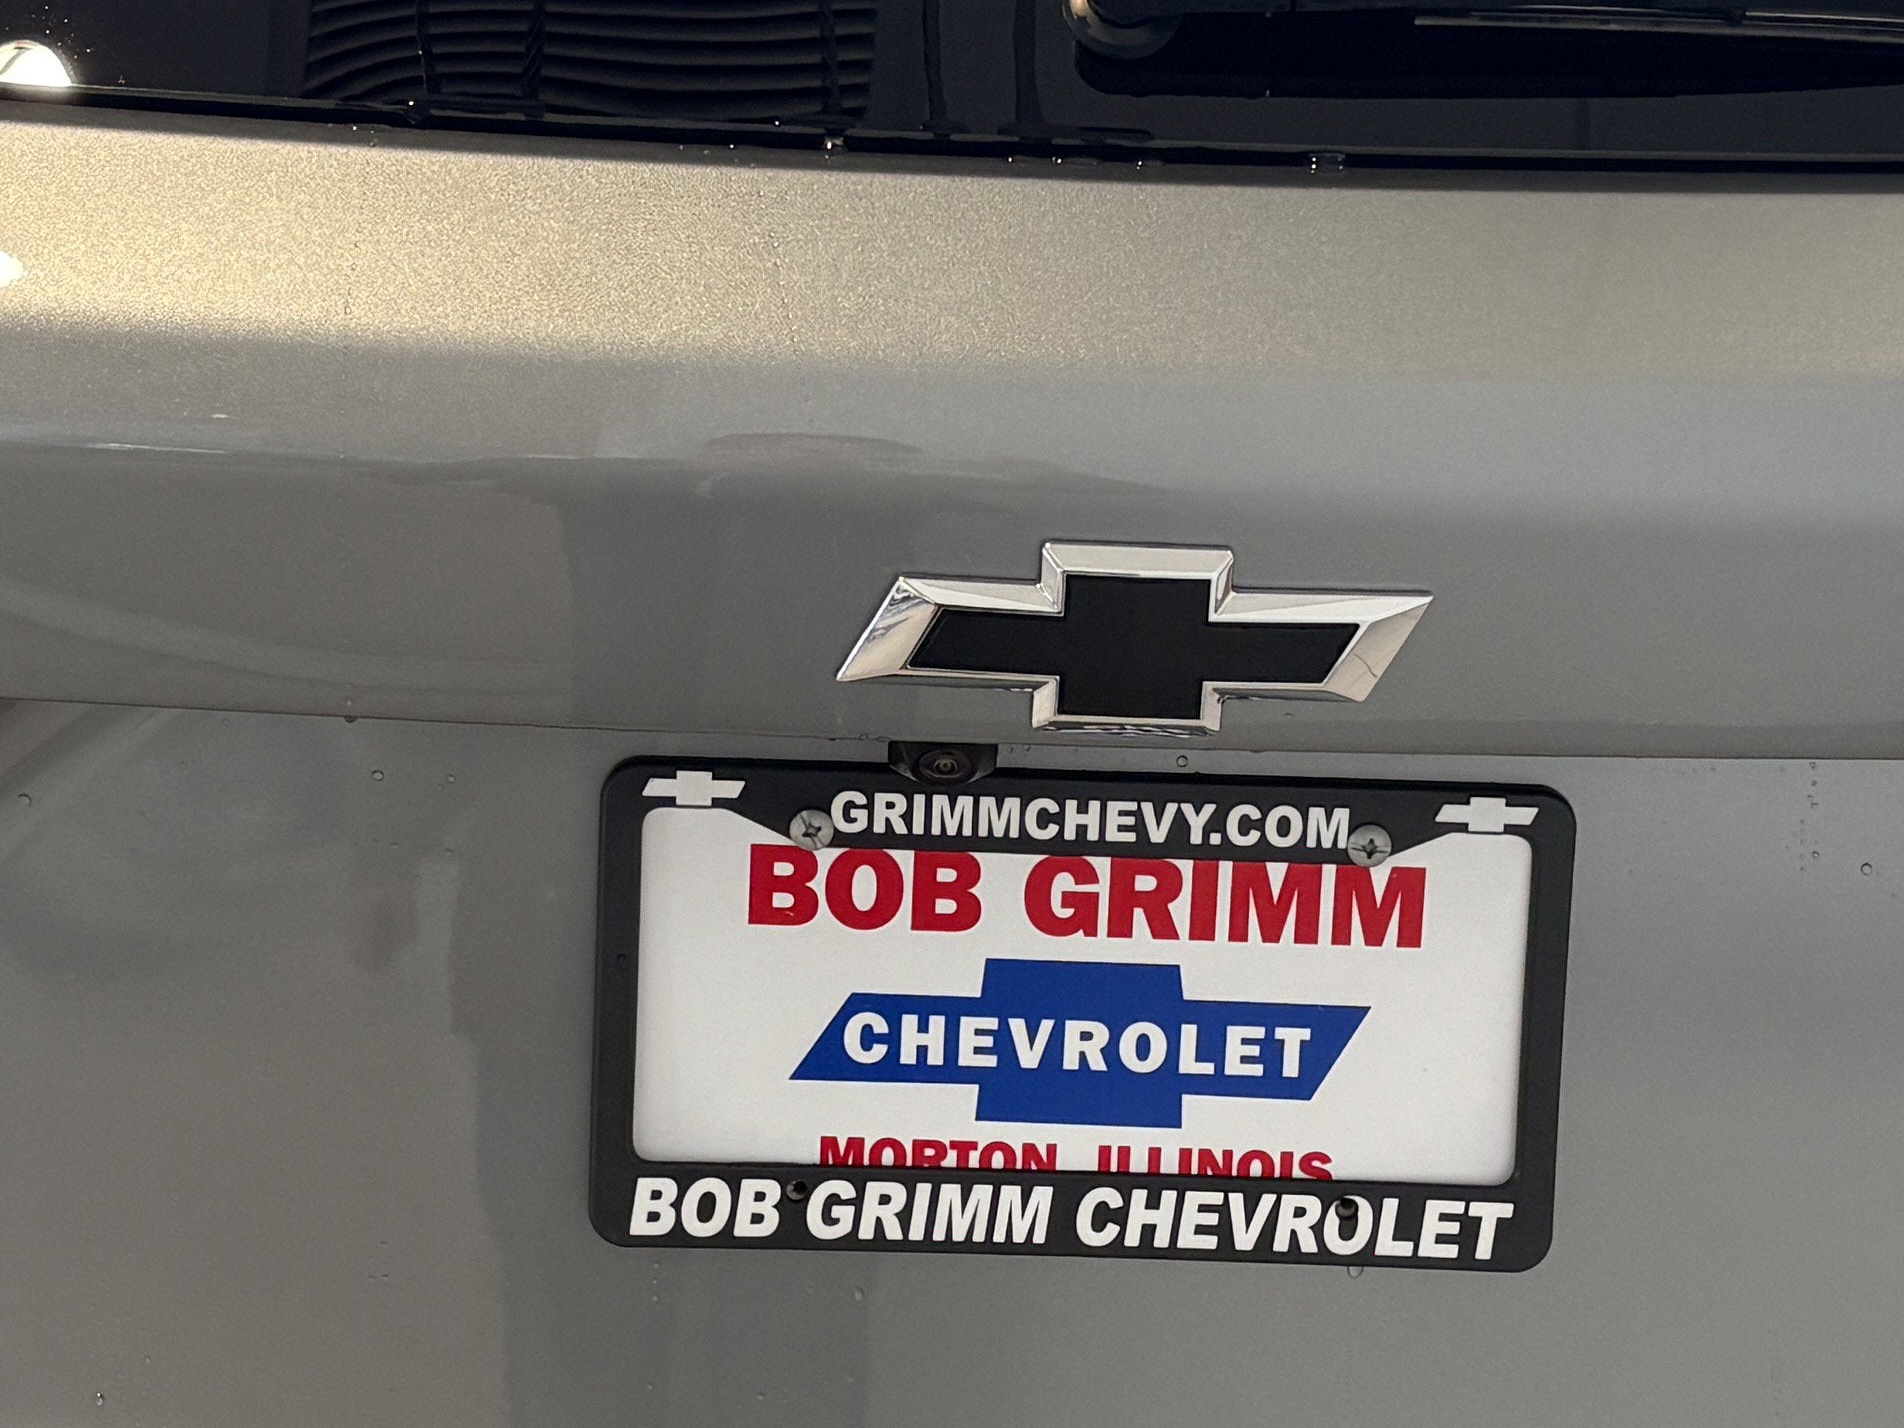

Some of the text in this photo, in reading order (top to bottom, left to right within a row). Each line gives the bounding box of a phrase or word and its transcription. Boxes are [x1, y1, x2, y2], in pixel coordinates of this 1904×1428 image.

[830, 790, 1351, 849] GRIMMCHEVY.COM
[748, 843, 1426, 949] BOB GRIMM
[842, 1011, 1312, 1078] CHEVROLET
[628, 1177, 1515, 1262] BOB GRIMM CHEVROLET
